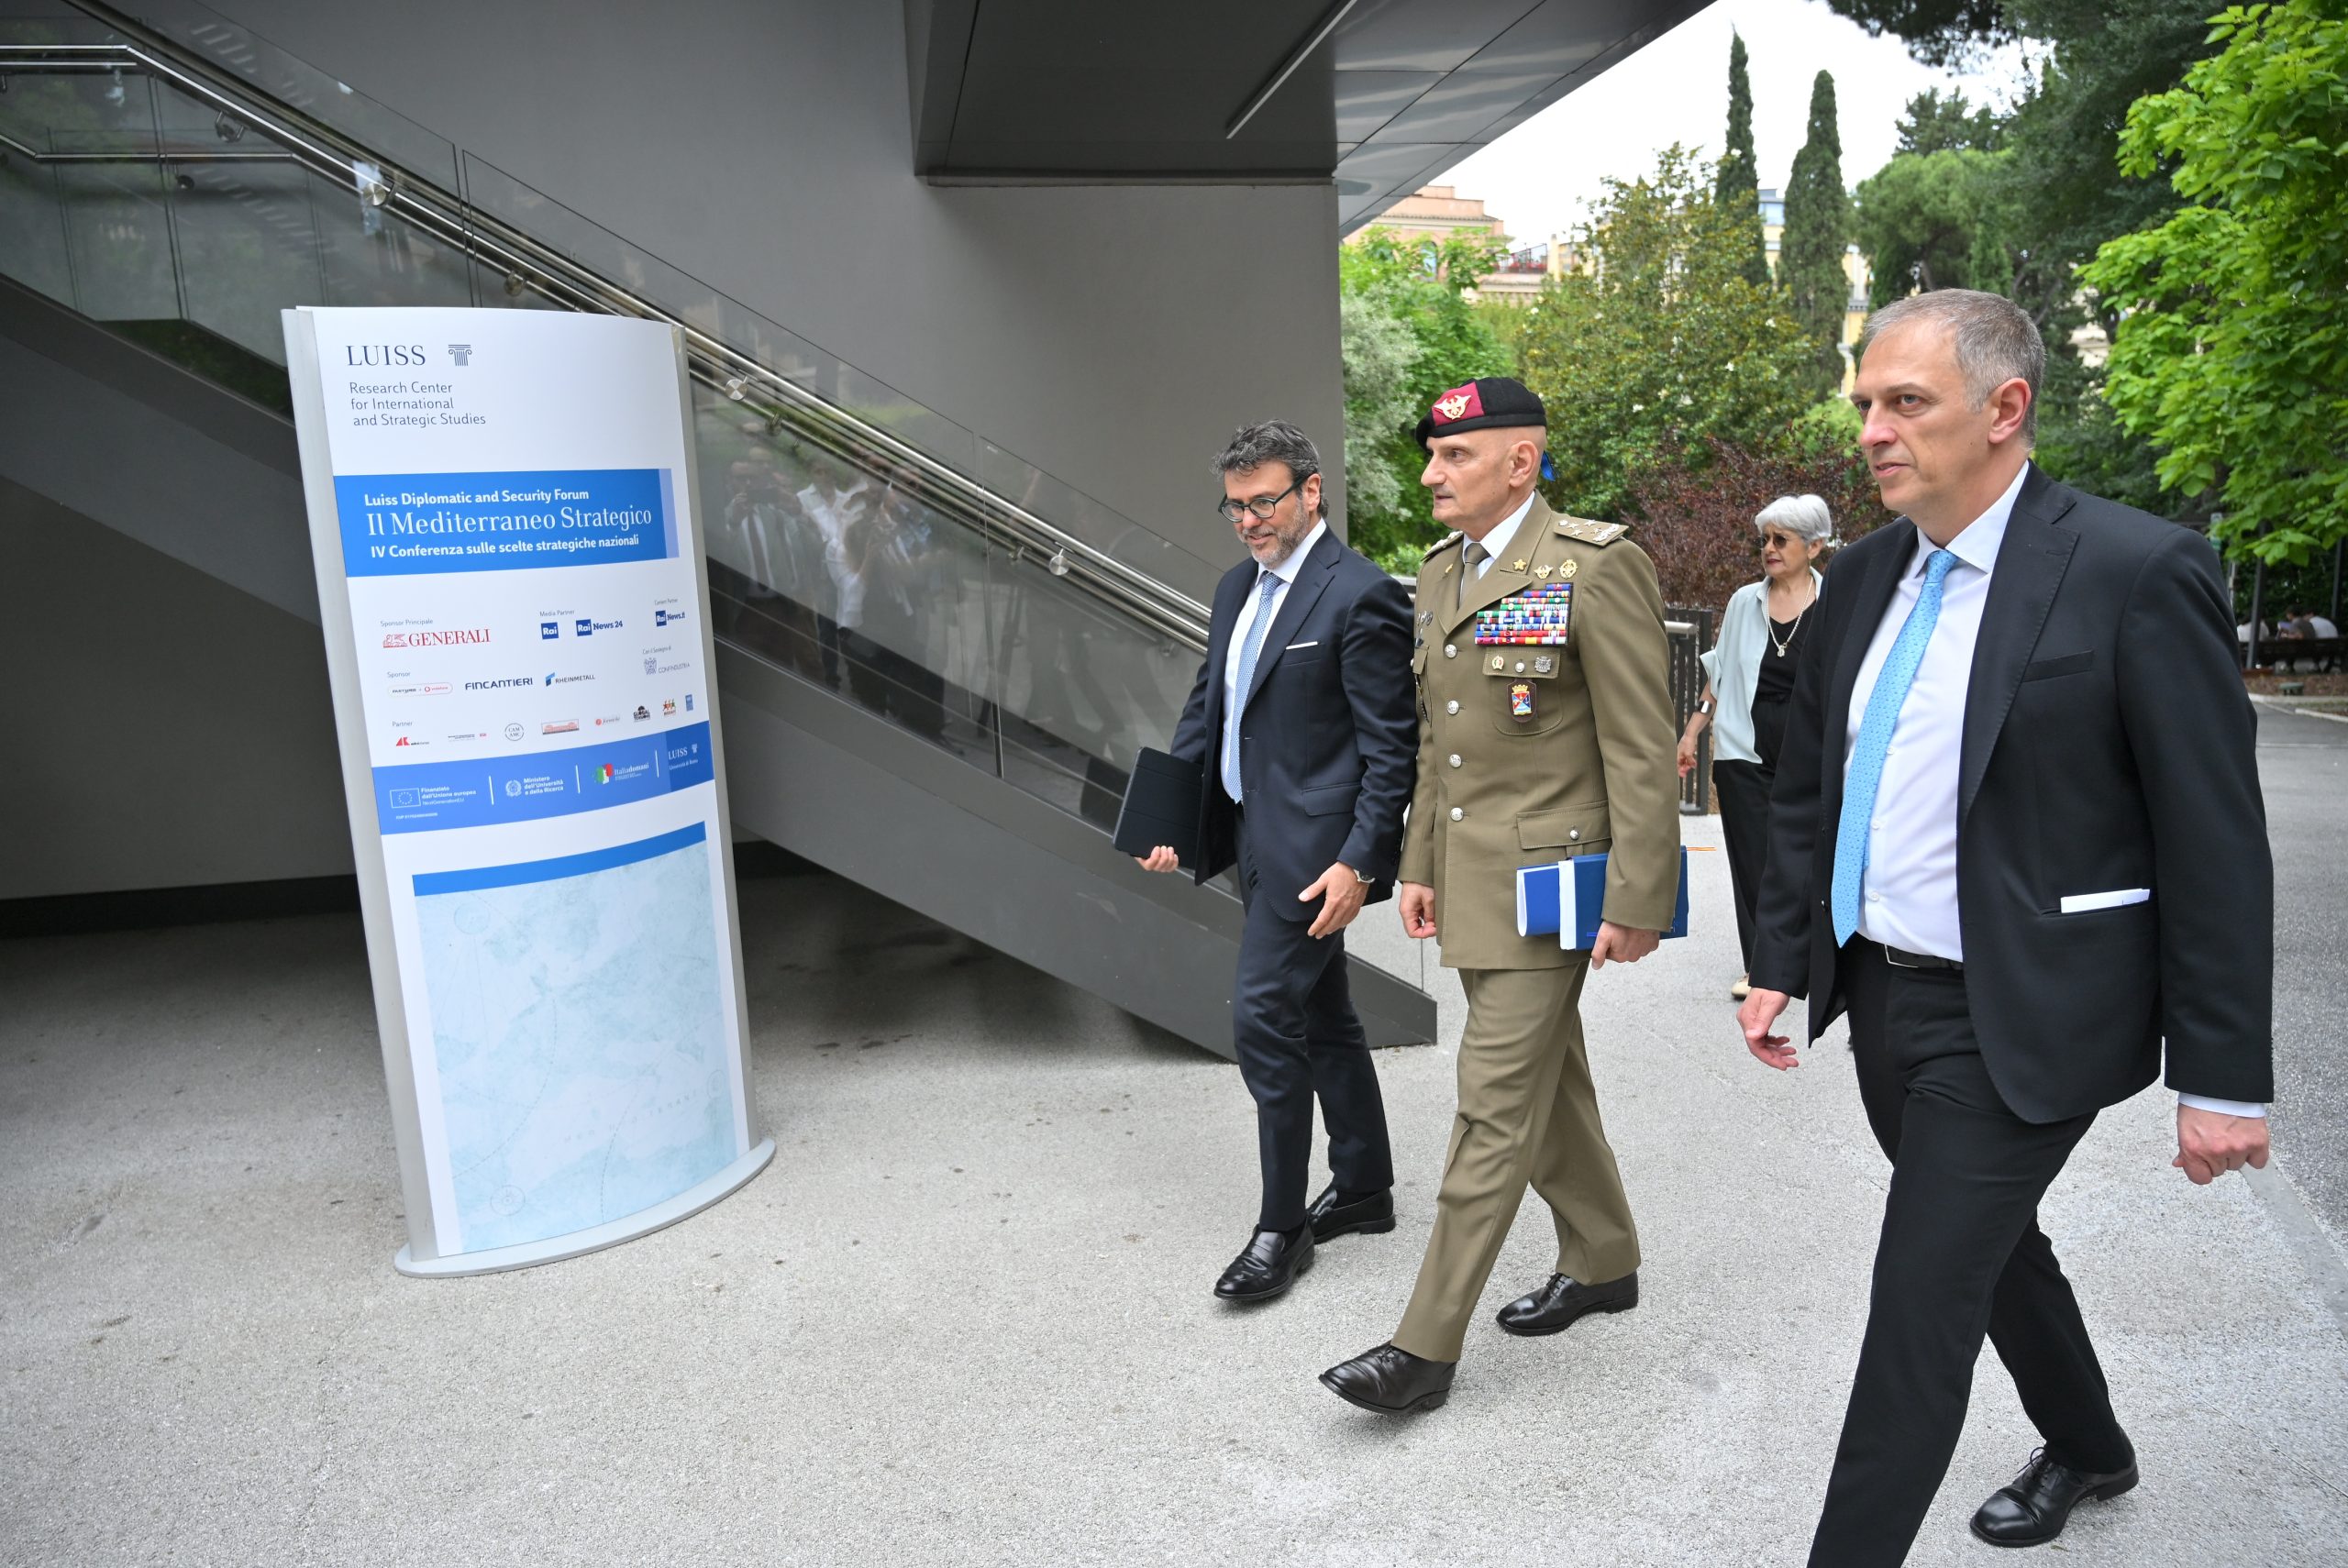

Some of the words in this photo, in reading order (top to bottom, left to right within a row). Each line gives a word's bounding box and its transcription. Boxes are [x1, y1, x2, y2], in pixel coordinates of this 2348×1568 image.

[346, 344, 426, 367] LUISS
[349, 381, 407, 394] Research
[411, 381, 453, 393] Center
[351, 397, 368, 410] for
[372, 396, 454, 410] International
[353, 414, 378, 426] and
[381, 413, 437, 429] Strategic
[440, 412, 486, 425] Studies
[364, 492, 398, 507] Luiss
[402, 490, 472, 508] Diplomatic
[475, 490, 500, 503] and
[503, 488, 552, 505] Security
[554, 488, 589, 502] Forum
[366, 513, 384, 536] Il
[392, 509, 556, 536] Mediterraneo
[560, 504, 652, 533] Strategico
[371, 546, 385, 558] IV
[389, 542, 463, 558] Conferenza
[466, 541, 495, 555] sulle
[498, 540, 534, 553] scelte
[536, 536, 596, 555] strategiche
[598, 535, 639, 548] nazionali
[380, 620, 404, 628] Sponsor
[405, 618, 433, 627] Principale
[577, 624, 592, 633] Rai
[593, 621, 615, 631] News
[615, 620, 624, 628] 24
[408, 628, 492, 647] GENERALI
[542, 626, 558, 635] Rai
[464, 677, 533, 690] FINCANTIERI
[555, 674, 595, 684] RHEINMETALL
[668, 746, 688, 760] LUISS
